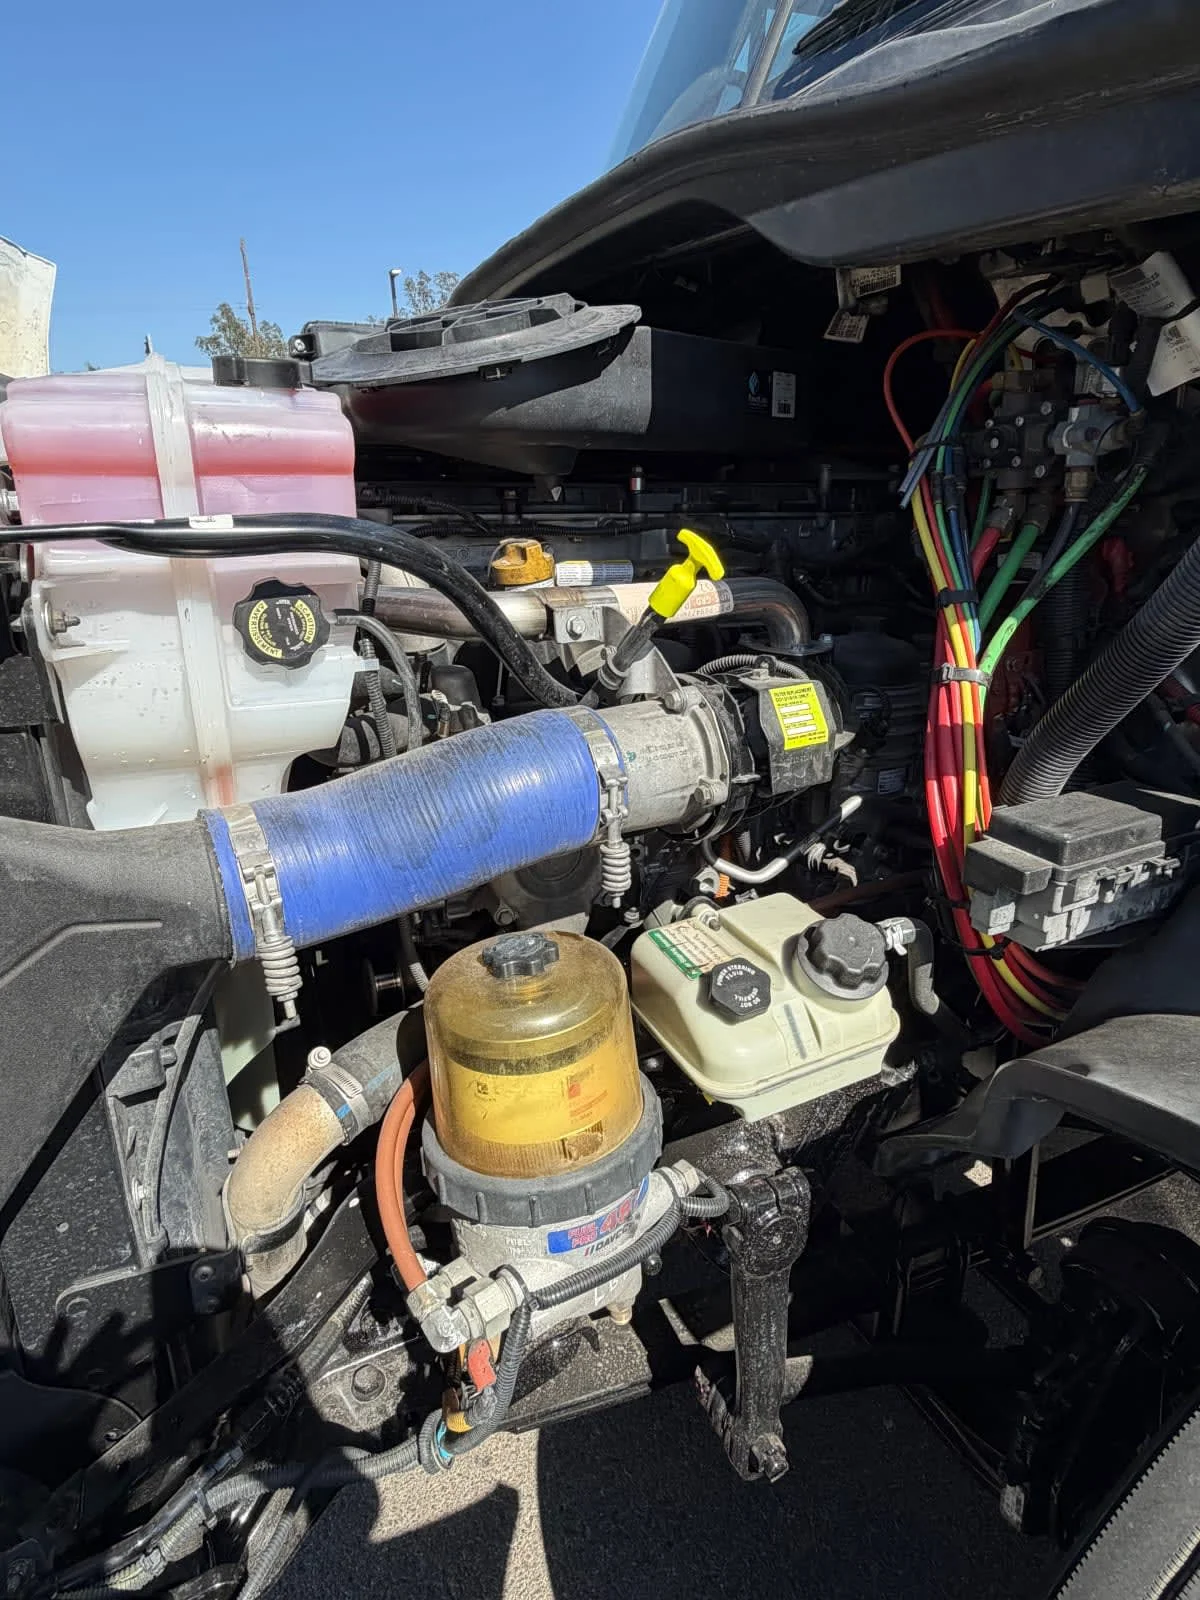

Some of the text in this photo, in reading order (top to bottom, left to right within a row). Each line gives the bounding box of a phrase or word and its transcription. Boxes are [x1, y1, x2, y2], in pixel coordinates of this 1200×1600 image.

[251, 608, 279, 656] AVERTISSEMENT
[302, 607, 315, 641] CAUTION
[727, 964, 756, 976] STEERING
